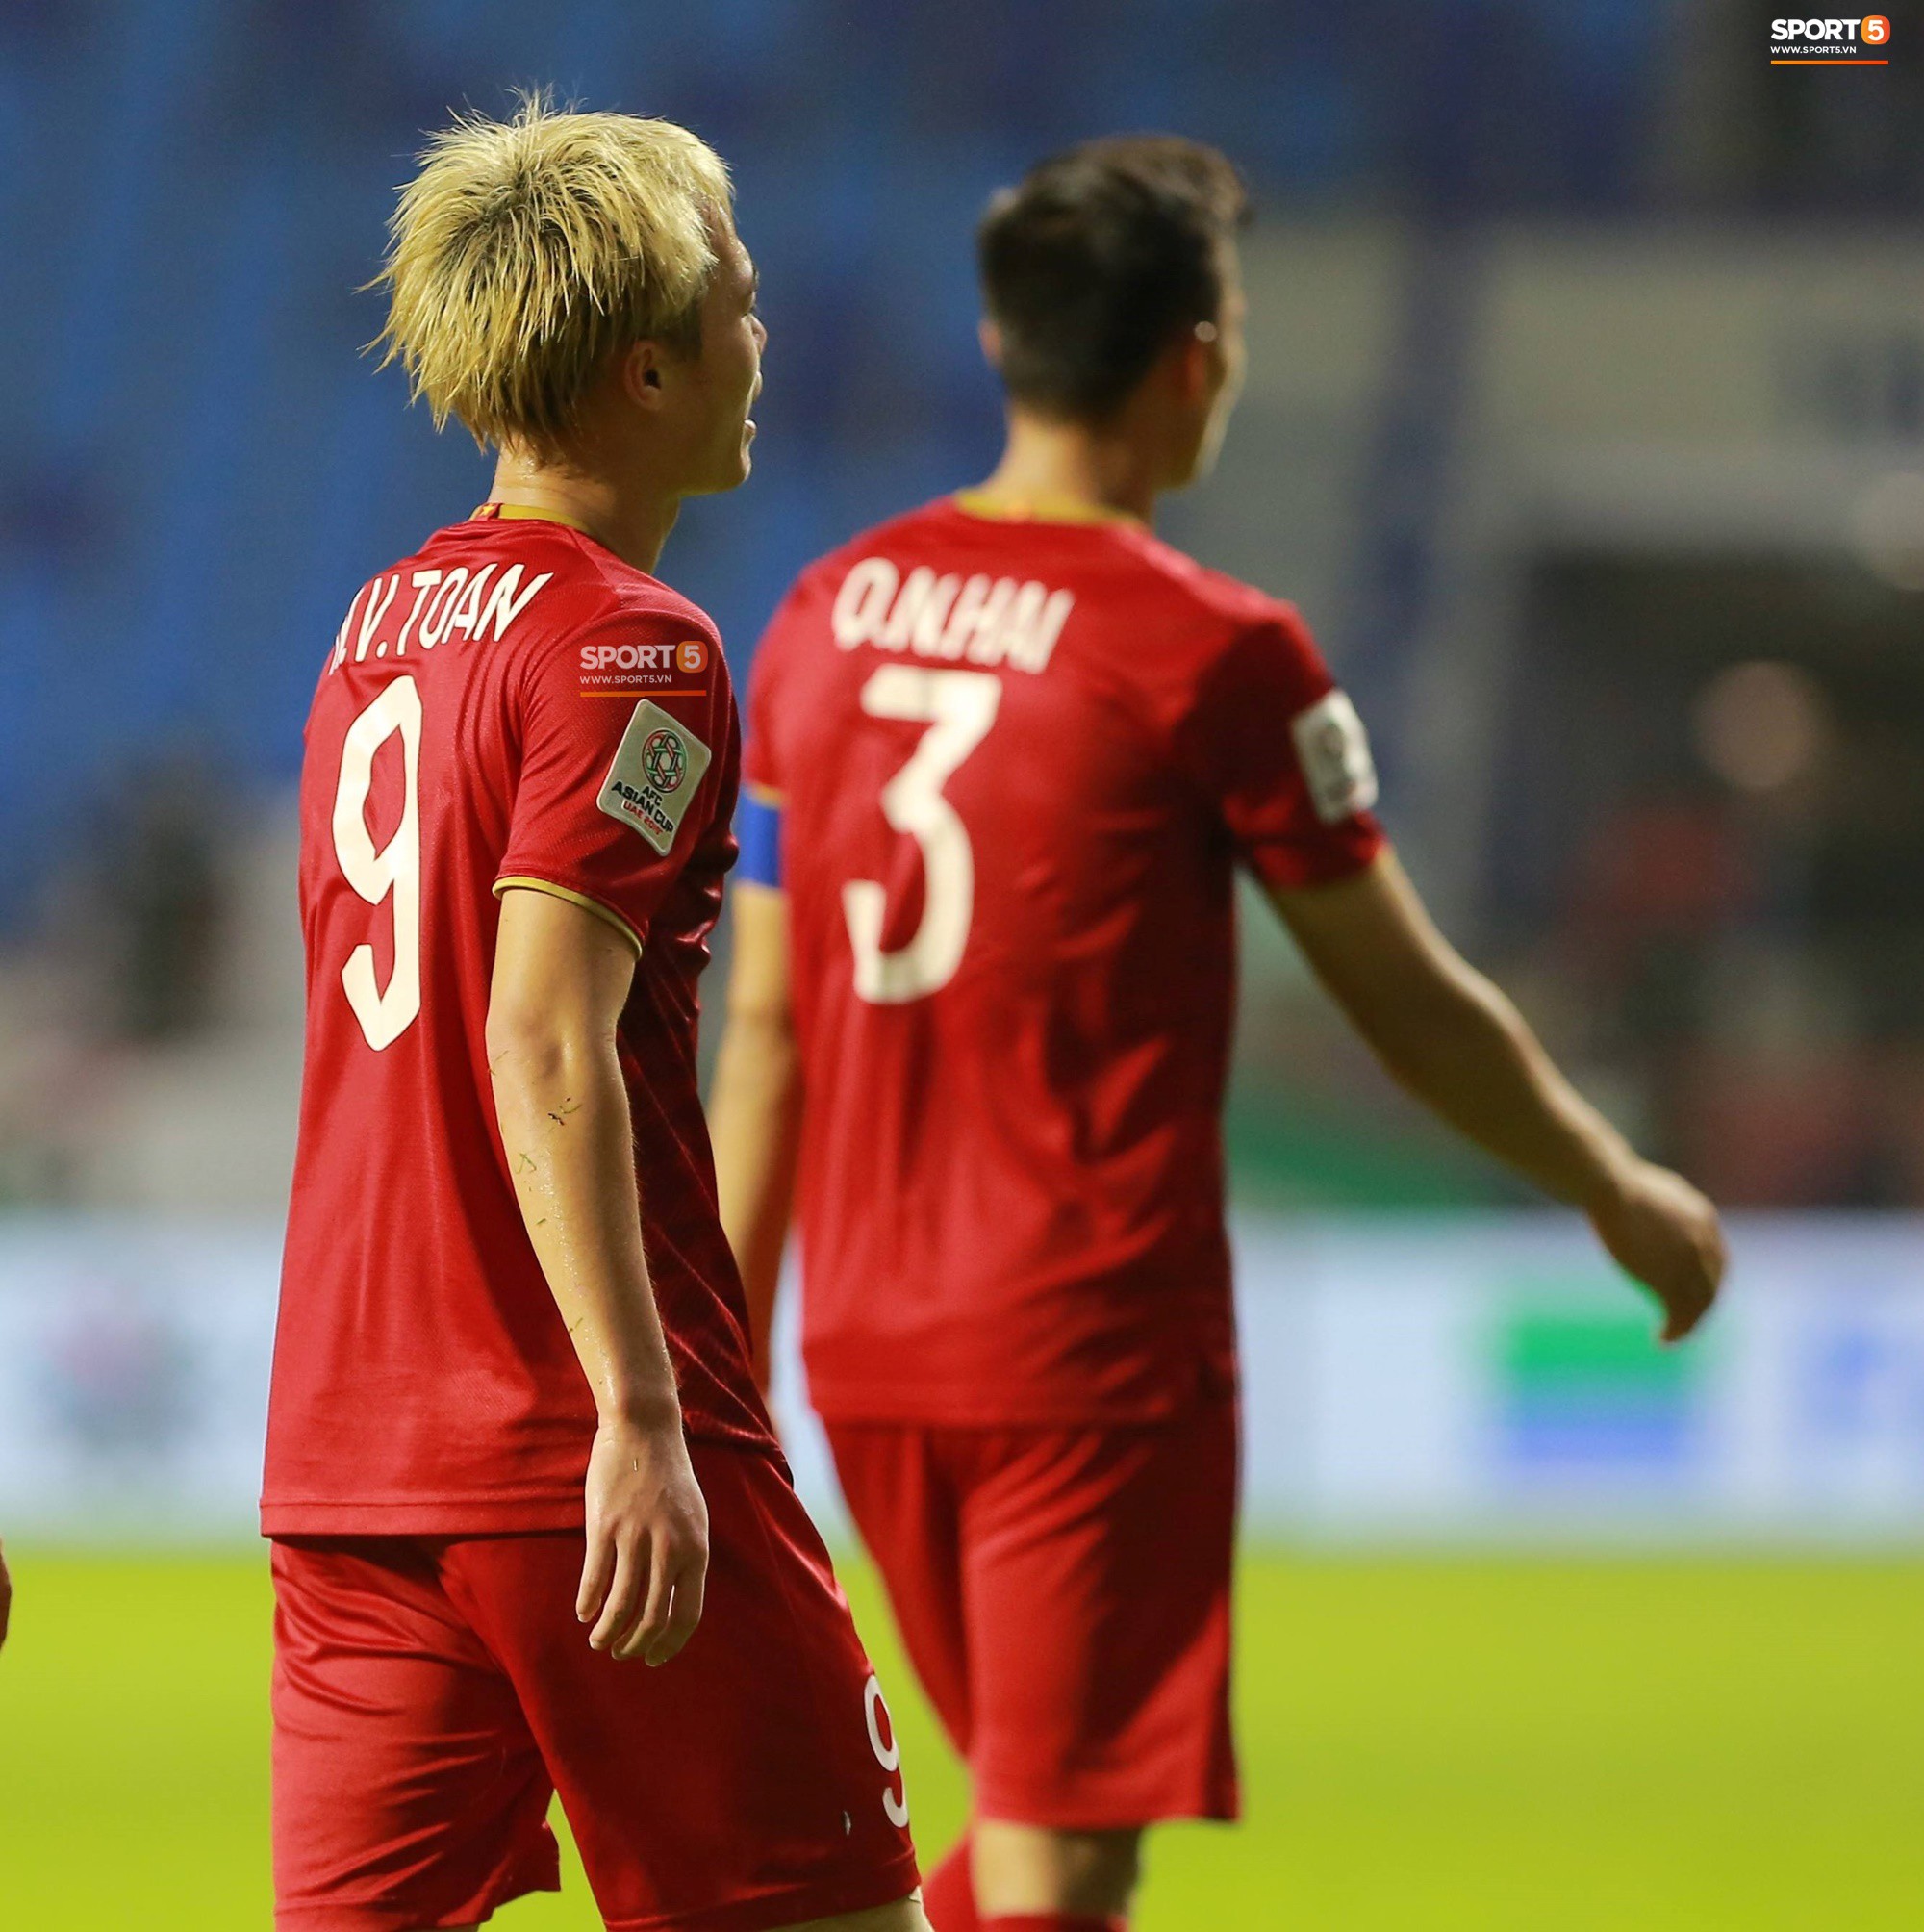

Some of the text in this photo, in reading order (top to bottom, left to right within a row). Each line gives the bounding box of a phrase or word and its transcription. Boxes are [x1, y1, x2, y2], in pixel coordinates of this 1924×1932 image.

[611, 781, 674, 833] ASIAN CUP
[623, 801, 645, 820] UAE
[642, 785, 663, 806] AFC
[841, 662, 1003, 1004] 3
[332, 674, 423, 1052] 9
[864, 1674, 909, 1828] 9
